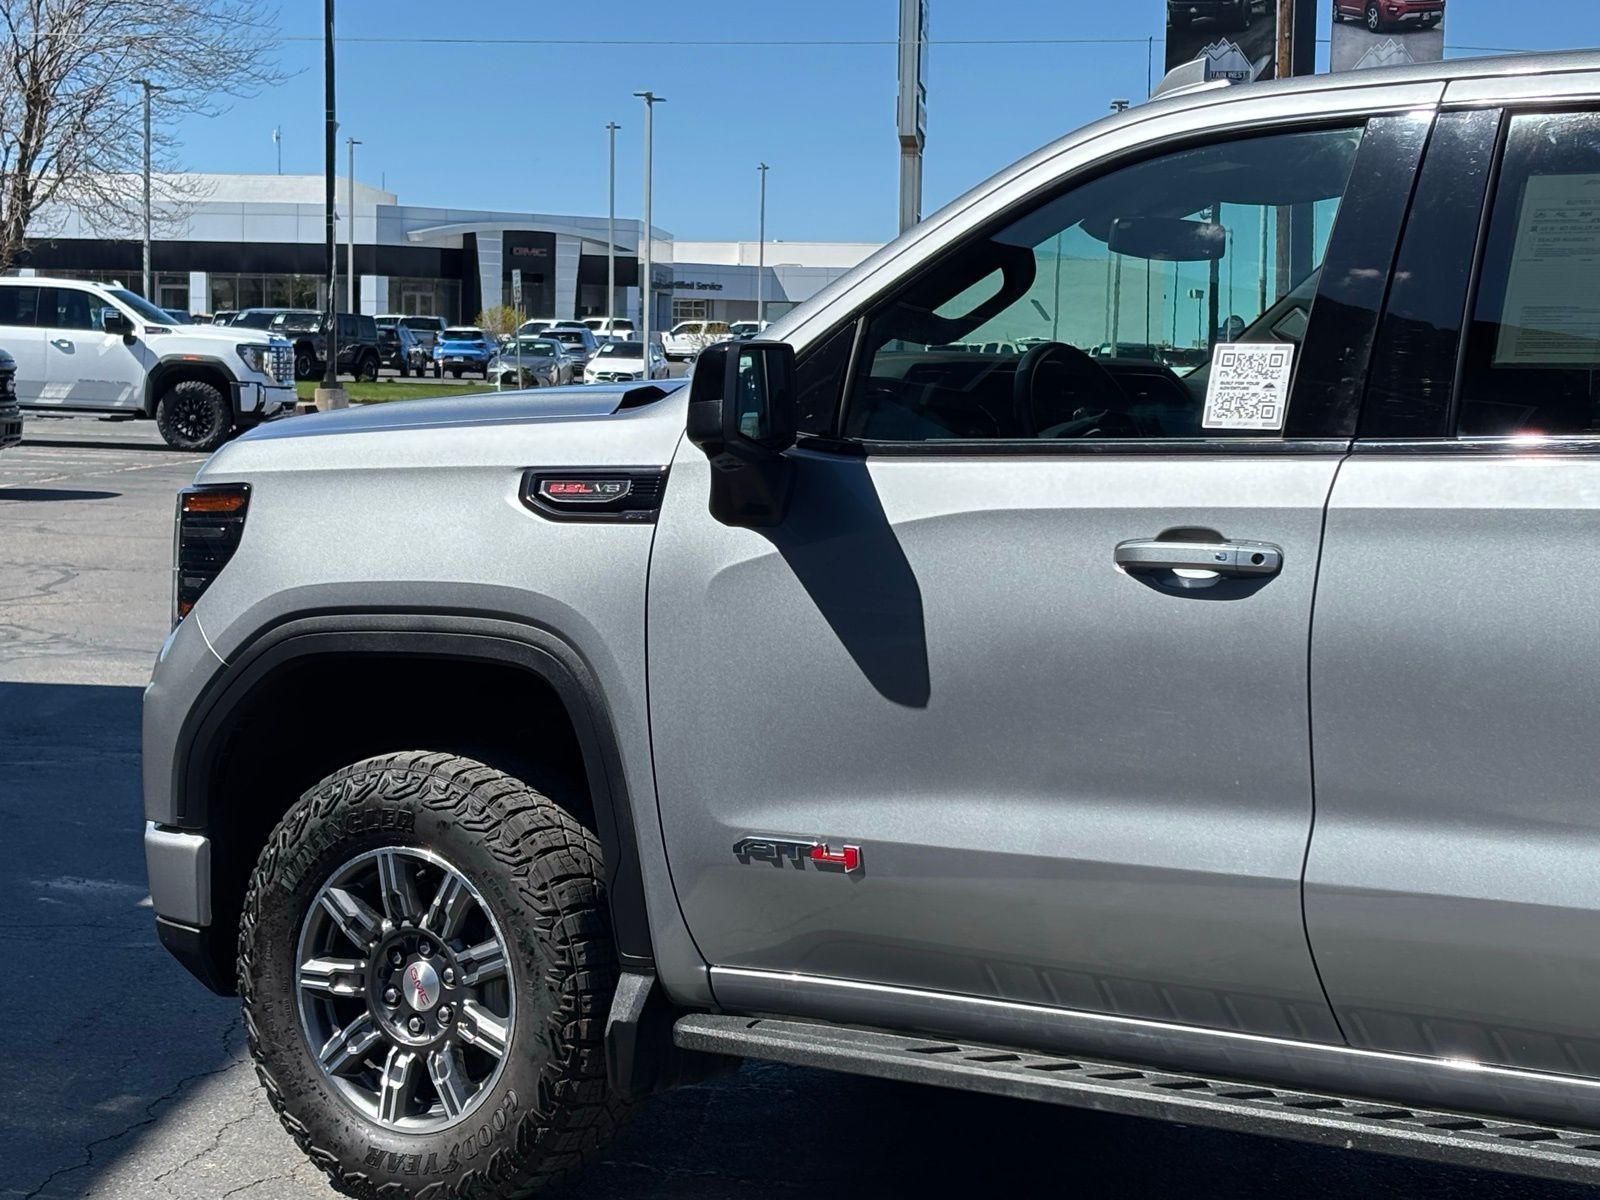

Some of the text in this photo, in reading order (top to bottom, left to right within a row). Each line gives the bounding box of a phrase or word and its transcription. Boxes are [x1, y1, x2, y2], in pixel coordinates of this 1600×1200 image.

[1228, 71, 1246, 79] WEST
[512, 247, 547, 257] GMC
[695, 281, 723, 291] Service
[595, 483, 620, 493] V8
[280, 808, 416, 893] WRANGLER
[732, 836, 861, 874] AT4
[410, 966, 431, 1006] GMC
[365, 1088, 519, 1177] GOODYEAR
